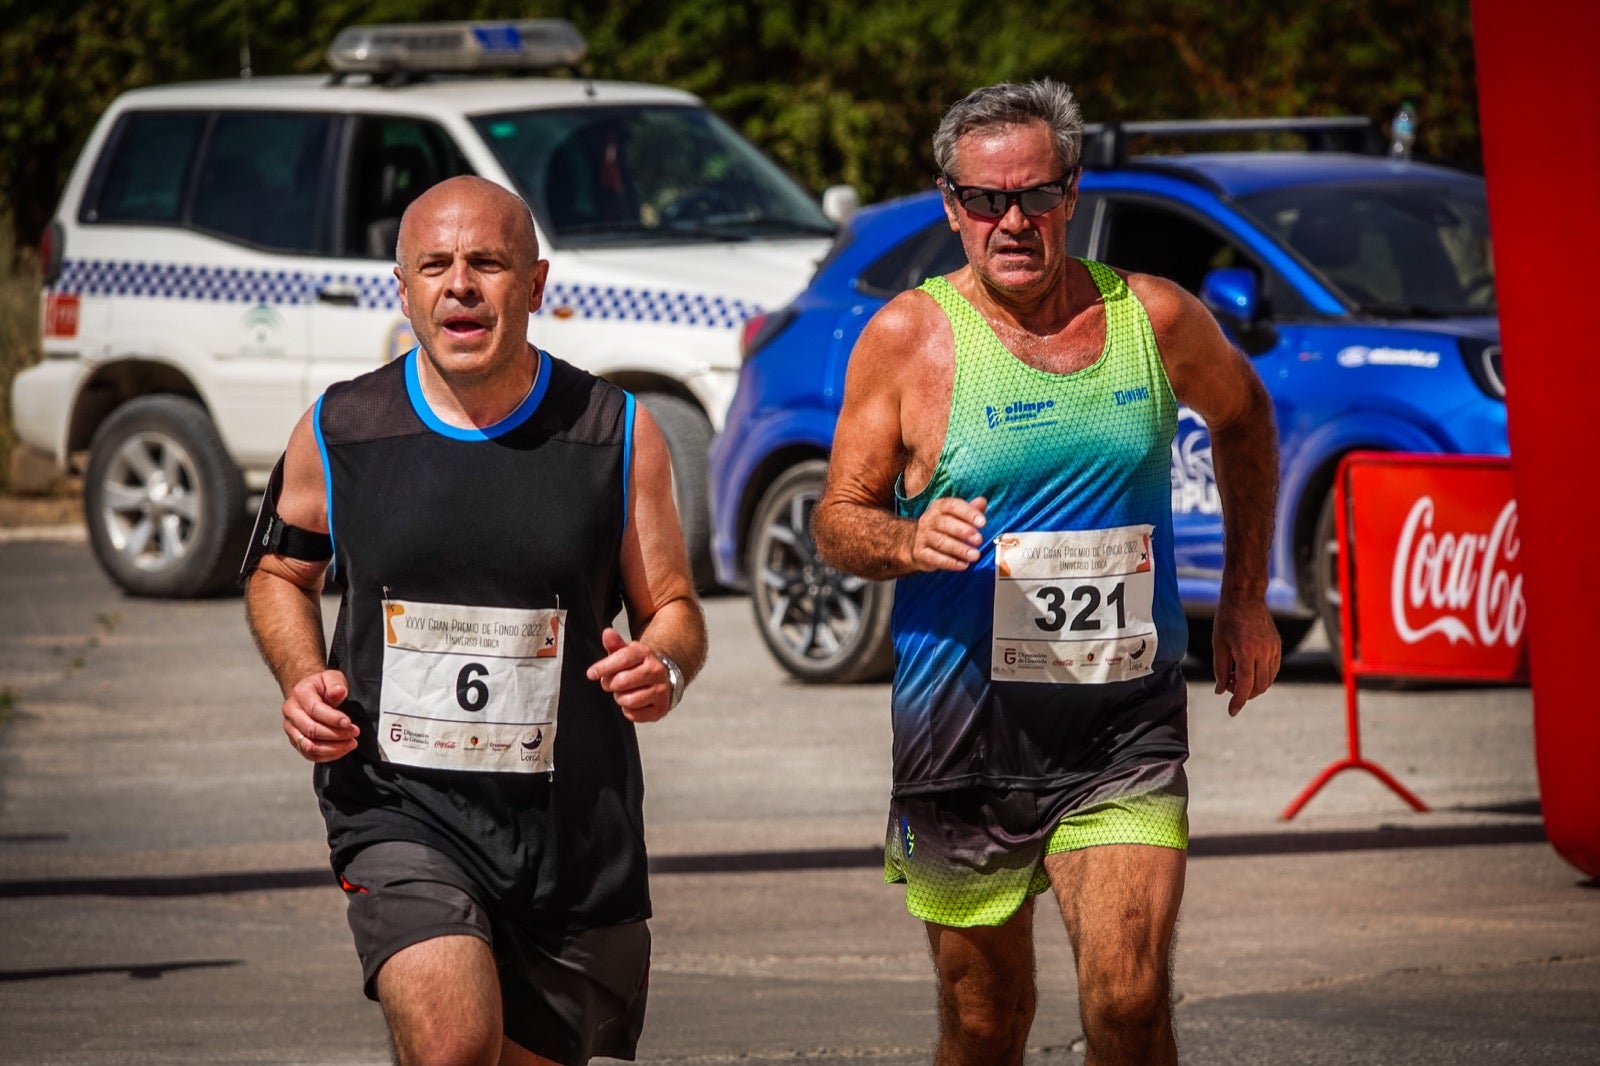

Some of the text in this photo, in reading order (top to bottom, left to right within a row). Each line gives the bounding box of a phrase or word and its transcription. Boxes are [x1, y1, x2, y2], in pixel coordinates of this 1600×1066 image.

[1005, 400, 1054, 414] olimpo
[1021, 546, 1041, 560] XXXV
[1123, 540, 1138, 554] 2022
[1391, 495, 1527, 648] Coca-Co
[1034, 582, 1126, 632] 321
[405, 616, 426, 630] XXXV
[428, 618, 449, 632] GRAN
[451, 619, 479, 634] PREMIO
[494, 621, 519, 637] FONDO
[521, 623, 542, 637] 2022
[455, 662, 490, 712] 6
